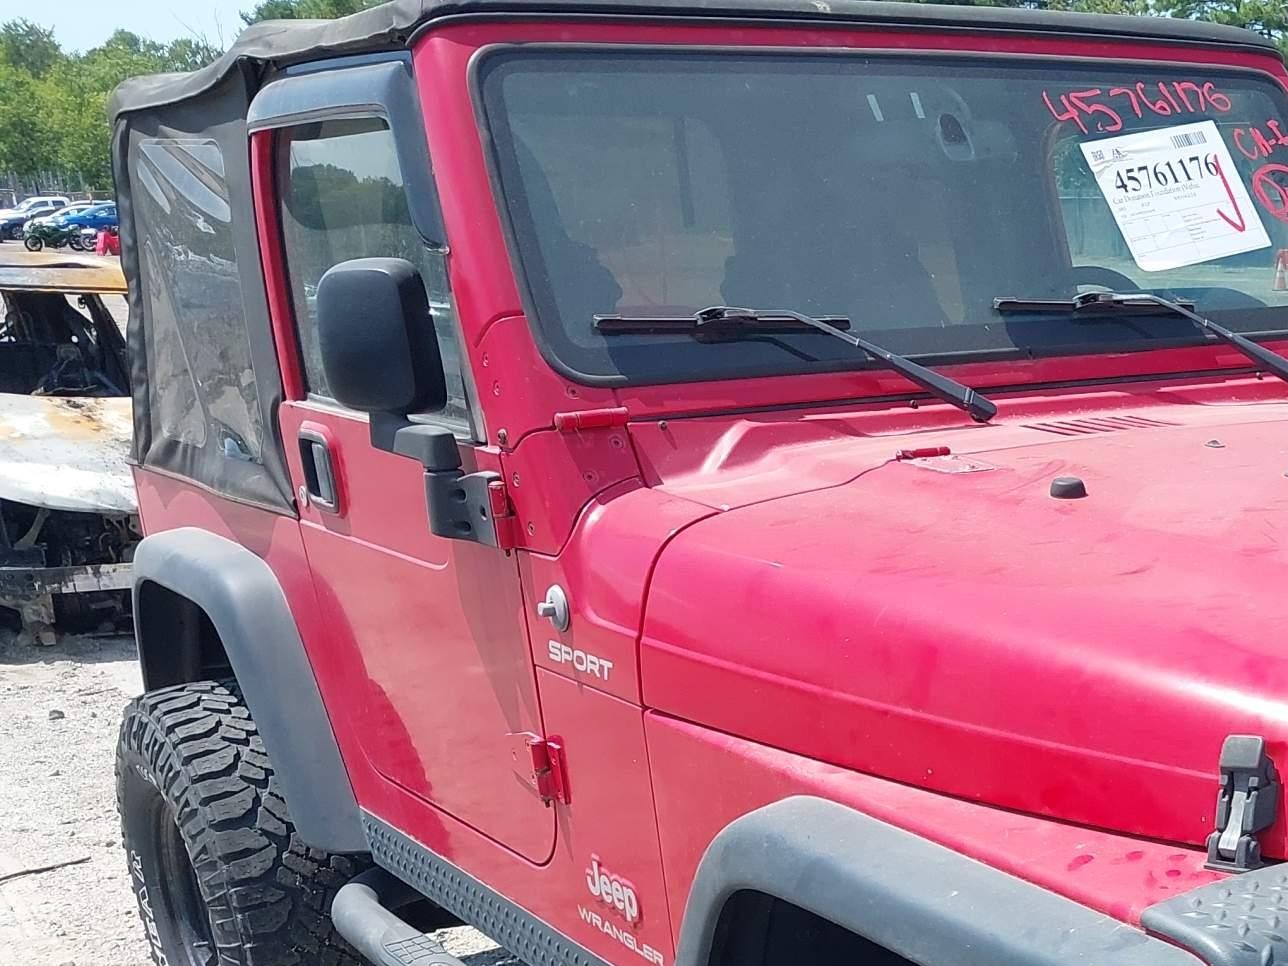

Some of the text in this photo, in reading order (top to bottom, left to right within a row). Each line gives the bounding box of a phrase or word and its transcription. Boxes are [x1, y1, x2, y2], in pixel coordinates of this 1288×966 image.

[1115, 153, 1219, 193] 45761176
[548, 638, 613, 681] SPORT
[585, 860, 639, 922] Jeep
